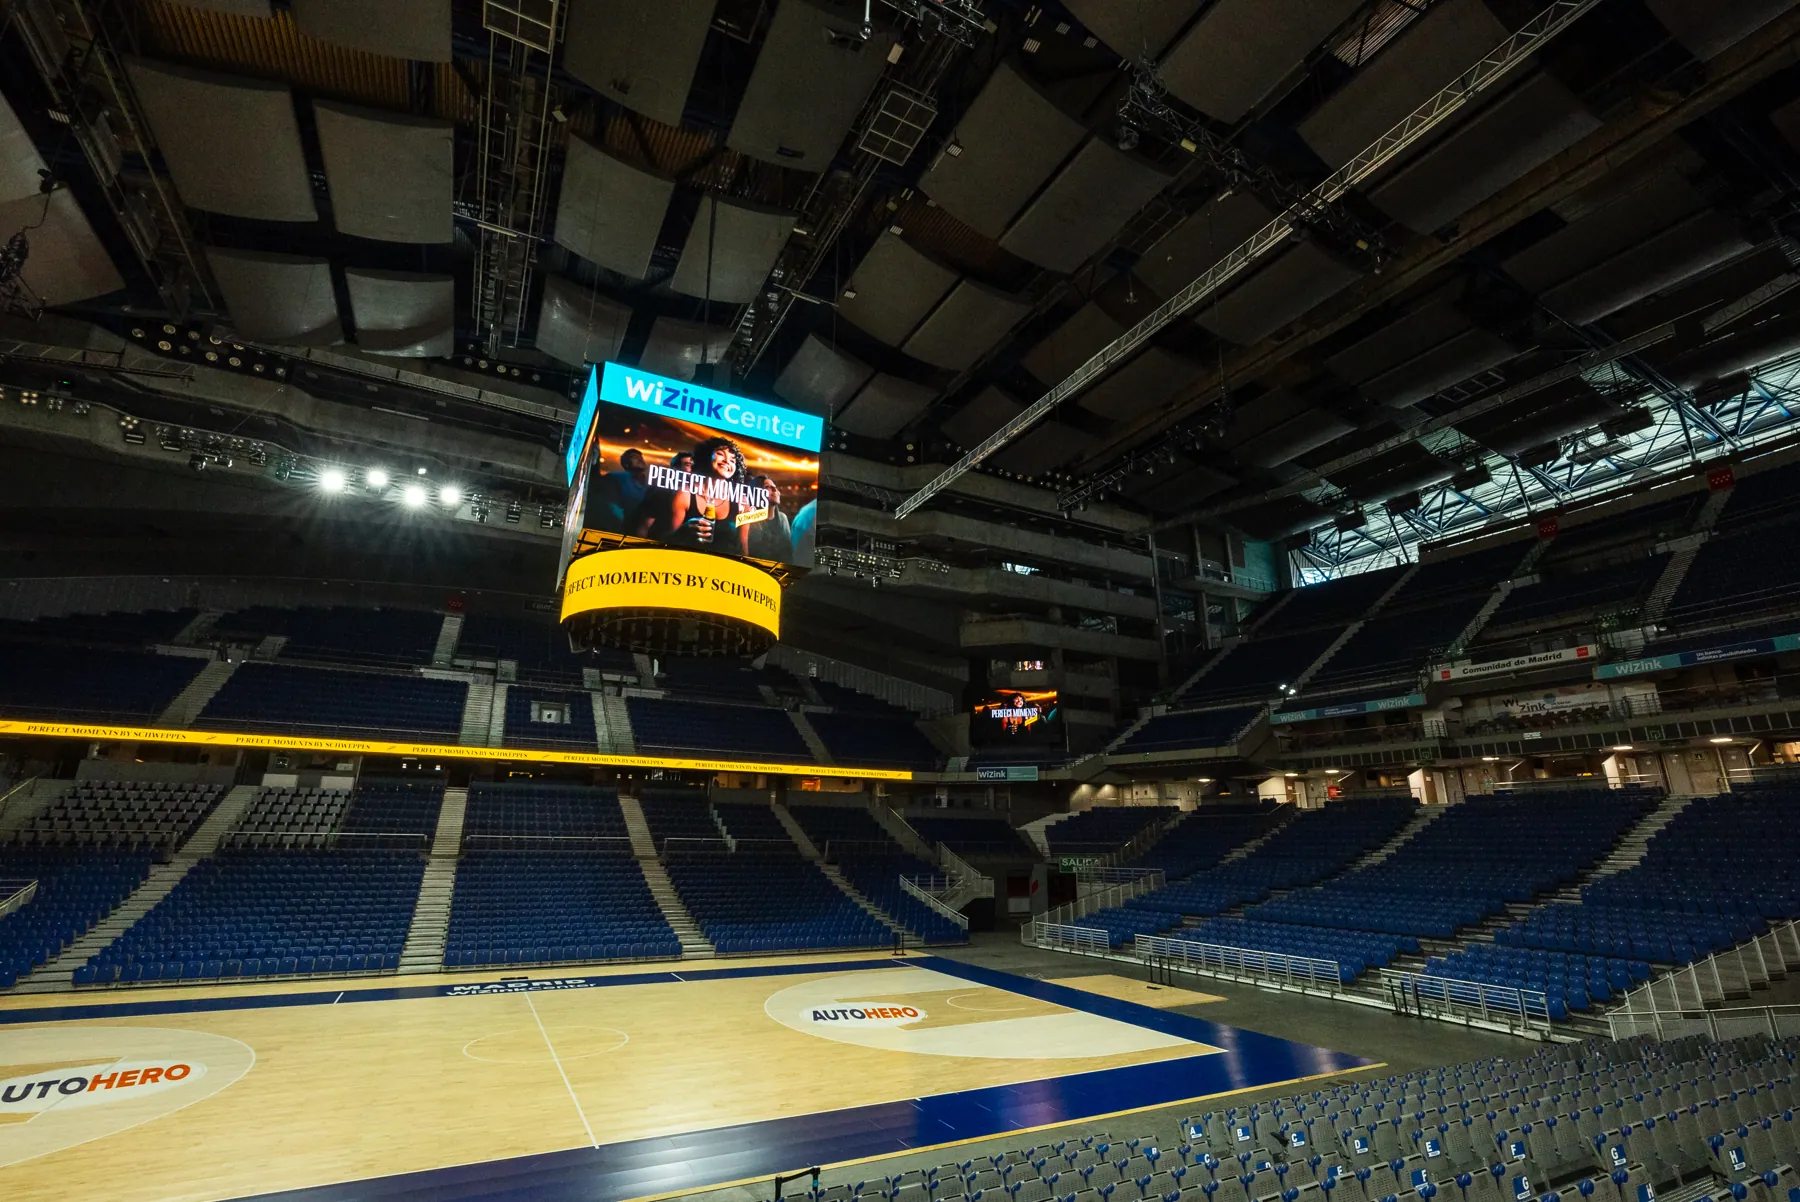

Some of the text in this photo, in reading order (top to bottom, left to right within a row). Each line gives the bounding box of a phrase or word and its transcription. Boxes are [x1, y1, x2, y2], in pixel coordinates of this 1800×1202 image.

[625, 376, 806, 440] WiZinkCenter
[647, 464, 770, 509] PERFECT MOMENTS
[597, 571, 682, 587] MOMENTS
[686, 574, 708, 588] BY
[711, 578, 777, 612] SCHWEPPES
[1462, 653, 1562, 675] Comunidad de Madrid
[991, 708, 1038, 718] PERFECT MOMENTS
[27, 725, 68, 733] PERFECT
[72, 728, 118, 736] MOMENTS
[133, 731, 186, 739] SCHWEPPES
[236, 737, 271, 745] PERFECT
[273, 739, 313, 747] MOMENTS
[325, 742, 371, 750] SCHWEPPES
[453, 979, 586, 991] MADRID
[812, 1007, 919, 1021] AUTOHERO
[1, 1064, 191, 1103] UTOHERO
[1189, 1126, 1196, 1135] A
[1237, 1129, 1243, 1137] B
[1291, 1133, 1297, 1142] C
[1354, 1139, 1361, 1149] D
[1425, 1141, 1433, 1151] E
[1510, 1144, 1516, 1155] F
[1204, 1154, 1210, 1163] C
[1611, 1147, 1618, 1159] G
[1729, 1149, 1739, 1164] H
[1422, 1169, 1427, 1182] F
[1522, 1176, 1529, 1190] G
[1646, 1183, 1655, 1198] H
